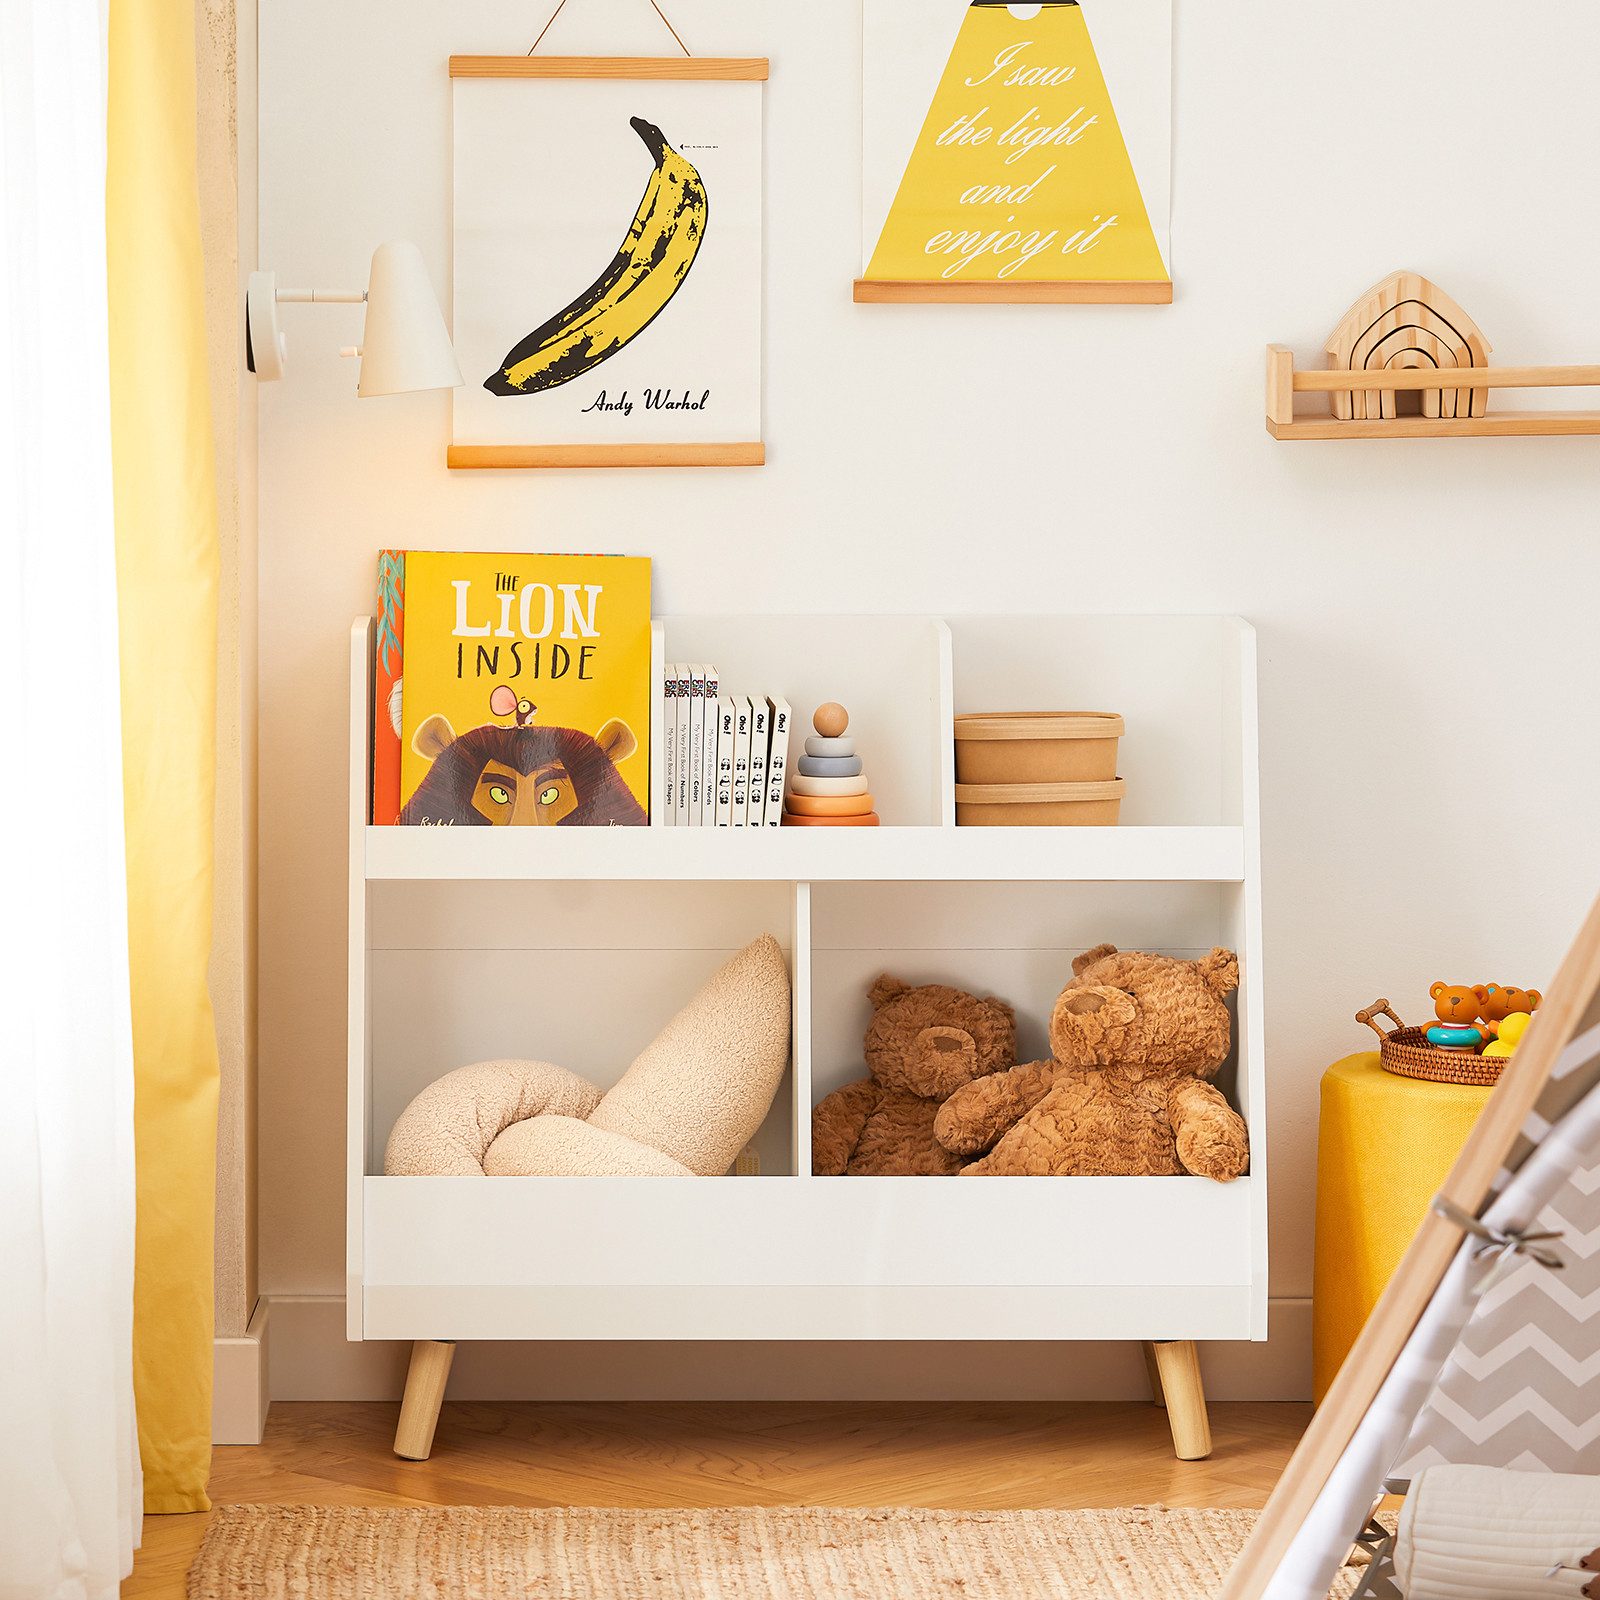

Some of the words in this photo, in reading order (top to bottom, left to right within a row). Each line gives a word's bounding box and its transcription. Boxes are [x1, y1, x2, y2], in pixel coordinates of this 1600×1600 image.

[965, 42, 1033, 86] I
[1004, 65, 1076, 86] saw
[936, 107, 992, 146] the
[997, 107, 1098, 164] light
[960, 165, 1057, 204] and
[925, 216, 1059, 278] enjoy
[1062, 215, 1118, 254] it
[581, 390, 633, 416] Andy
[644, 389, 709, 410] Warhol
[494, 572, 520, 592] THE
[457, 642, 597, 679] INSIDE
[778, 713, 786, 733] Oho!
